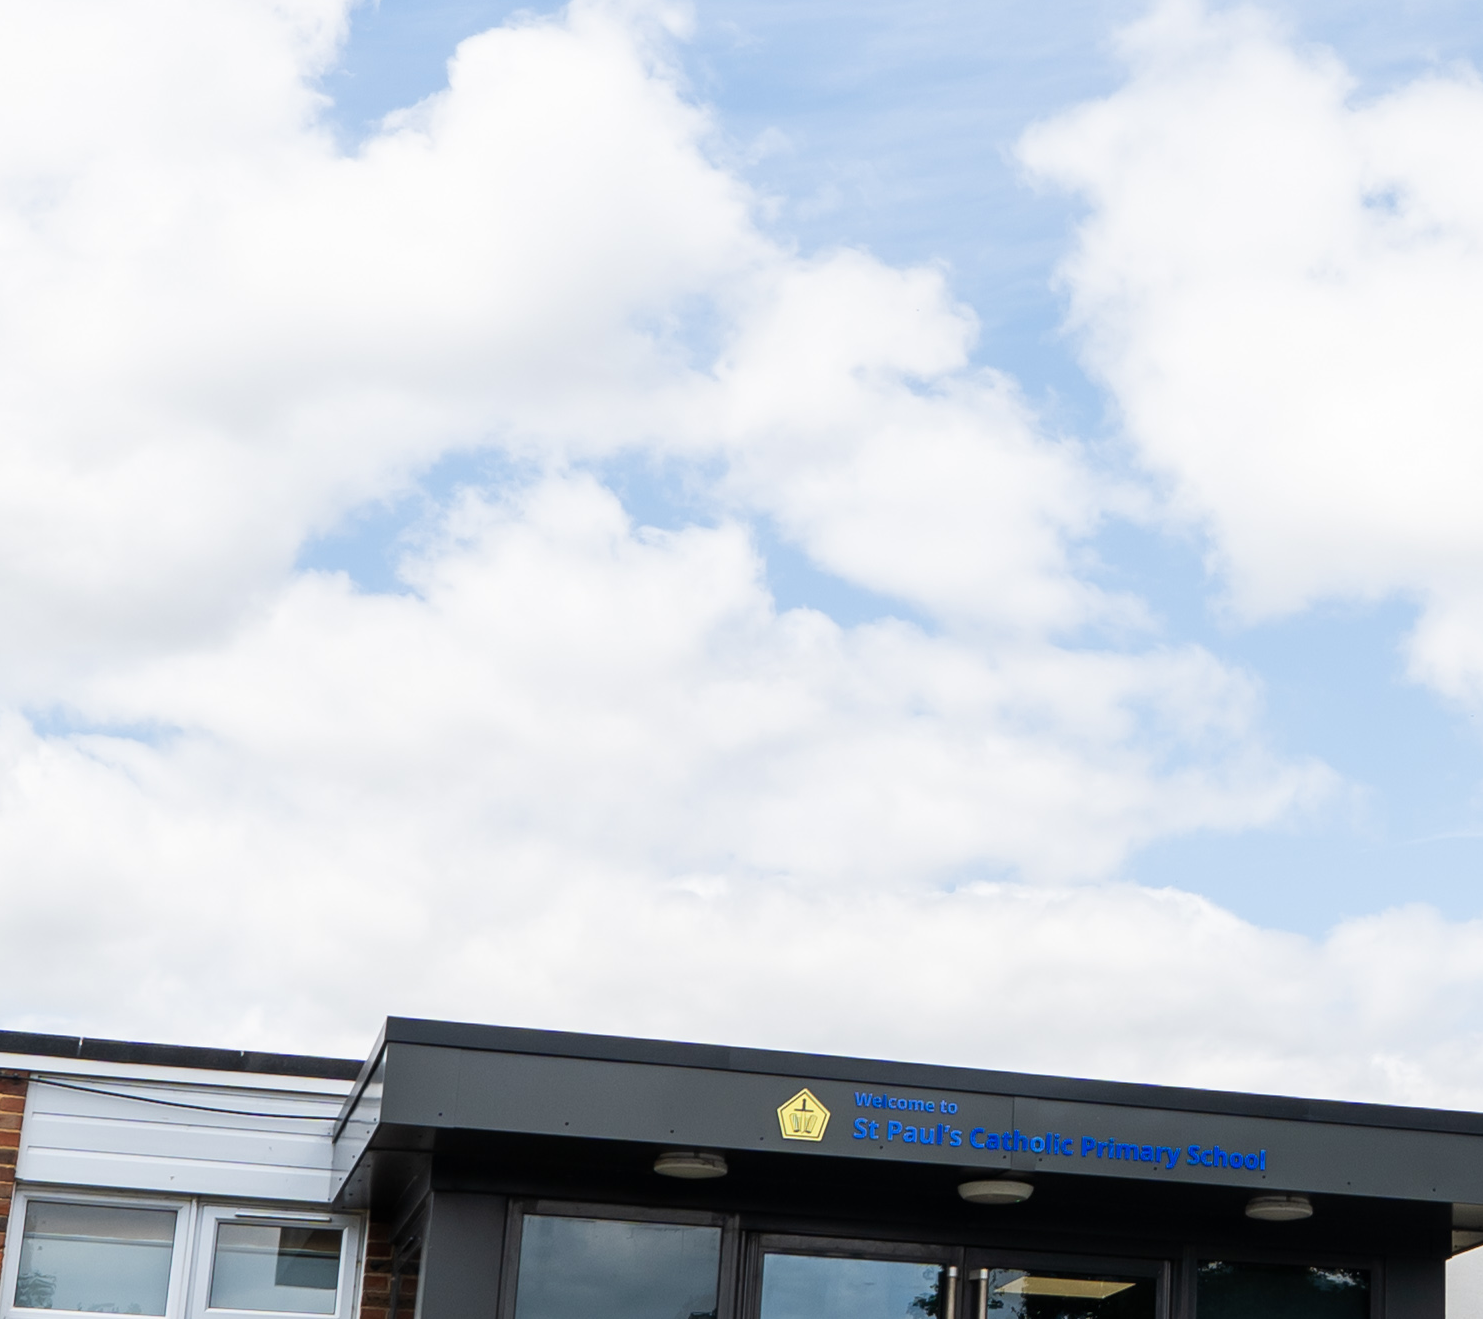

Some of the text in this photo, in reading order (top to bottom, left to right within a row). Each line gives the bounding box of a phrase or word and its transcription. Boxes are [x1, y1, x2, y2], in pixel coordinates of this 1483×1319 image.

[854, 1092, 959, 1115] Welcome to
[853, 1117, 1266, 1171] St Paul's Catholic Primary School
